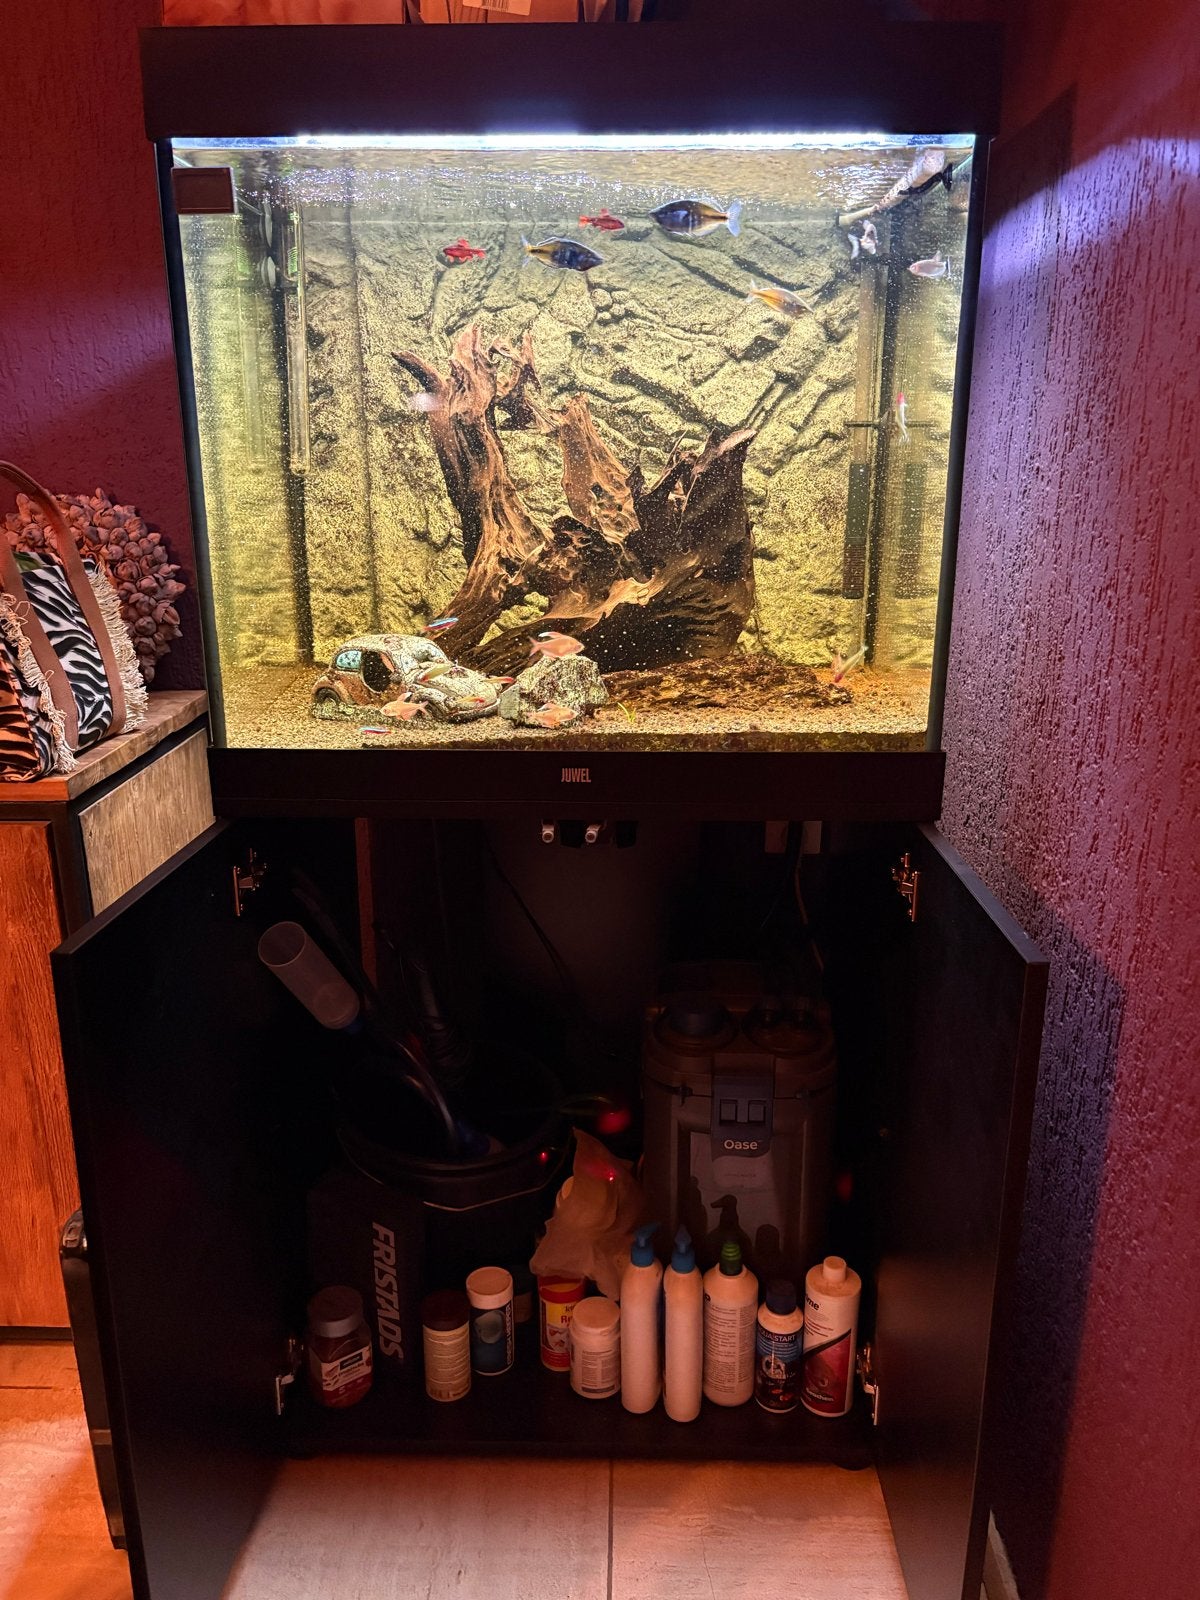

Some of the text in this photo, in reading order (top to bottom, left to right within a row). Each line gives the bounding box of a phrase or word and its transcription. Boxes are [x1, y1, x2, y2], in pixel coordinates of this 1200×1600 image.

[561, 767, 591, 783] JUWEL
[724, 1139, 758, 1150] Oase
[372, 1221, 404, 1360] FRISTADS
[774, 1334, 796, 1343] START
